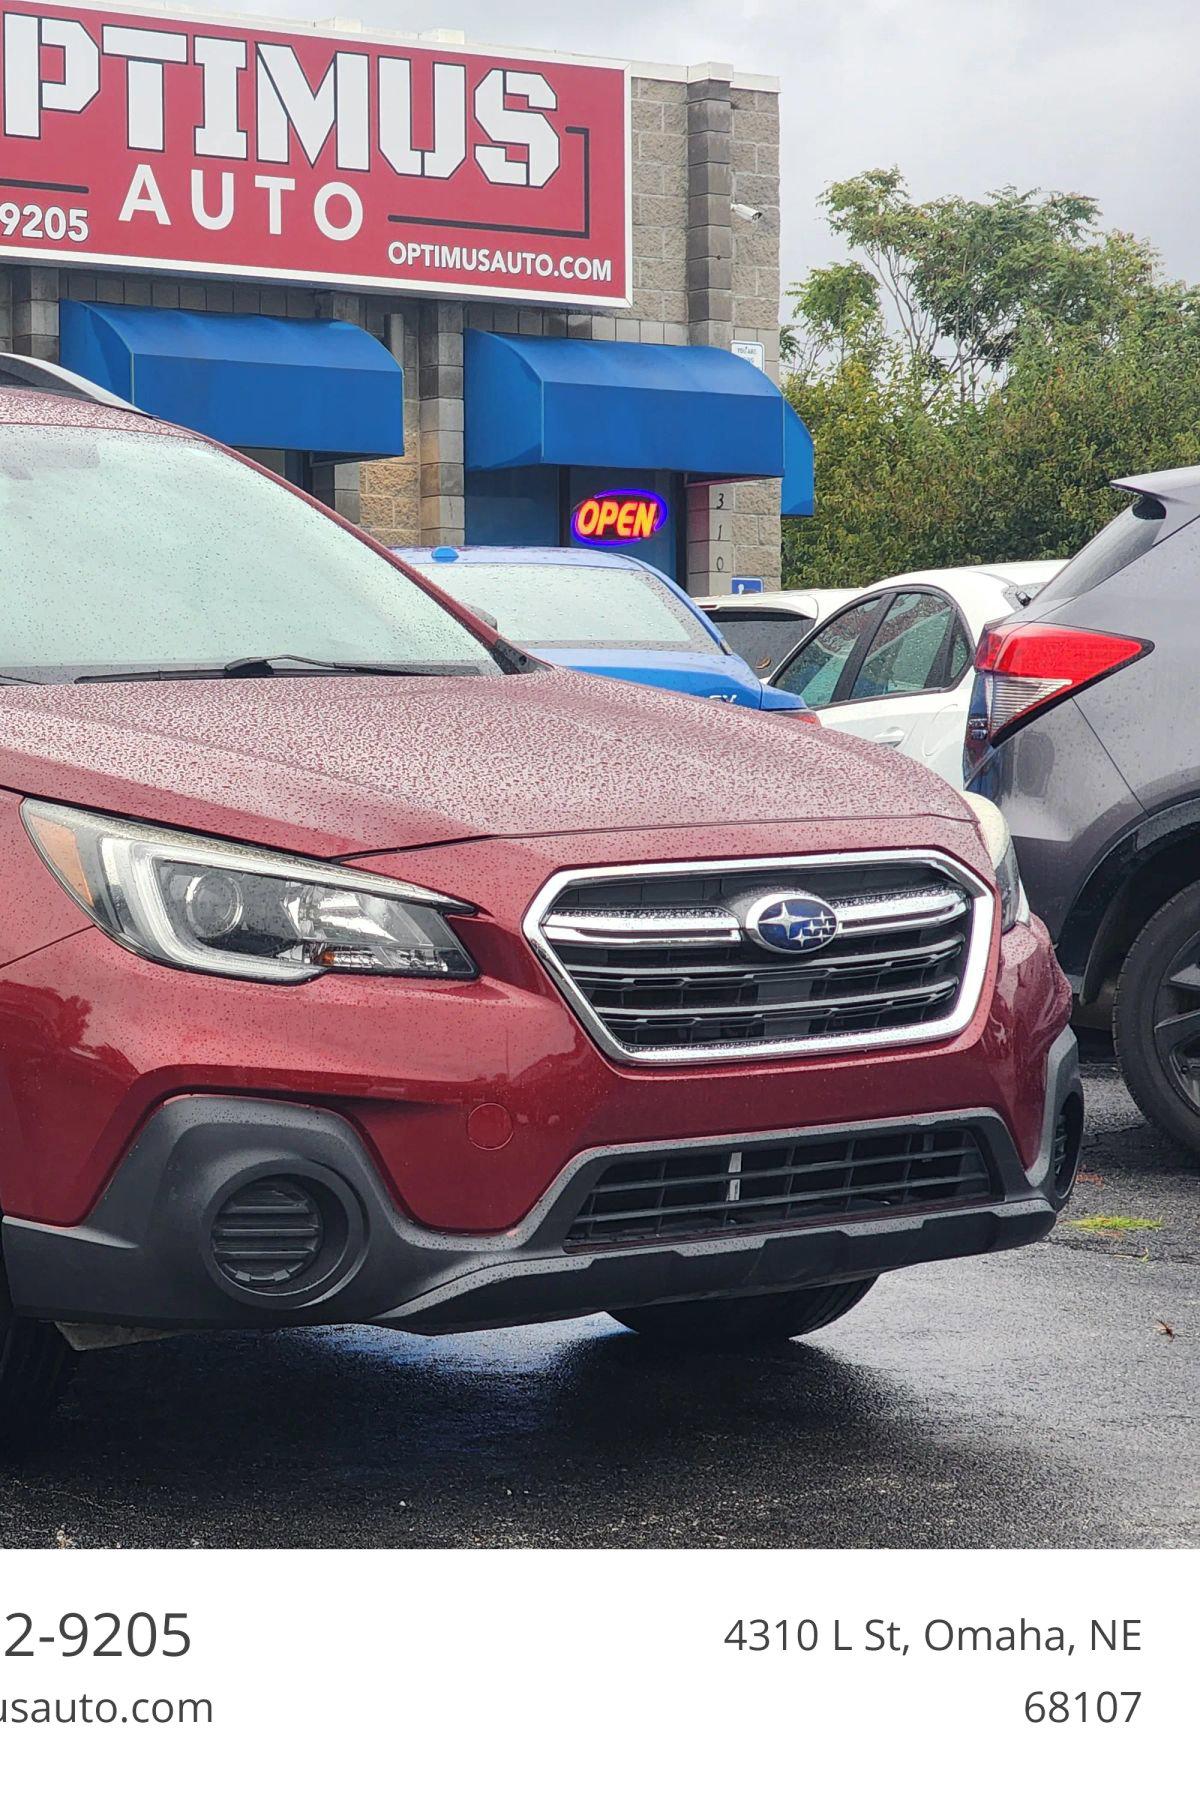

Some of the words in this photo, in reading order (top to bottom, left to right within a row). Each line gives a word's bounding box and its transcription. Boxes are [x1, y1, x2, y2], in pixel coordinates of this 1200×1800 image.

[118, 163, 364, 241] AUTO
[388, 241, 612, 282] OPTIMUSAUTO.COM
[577, 500, 657, 537] OPEN
